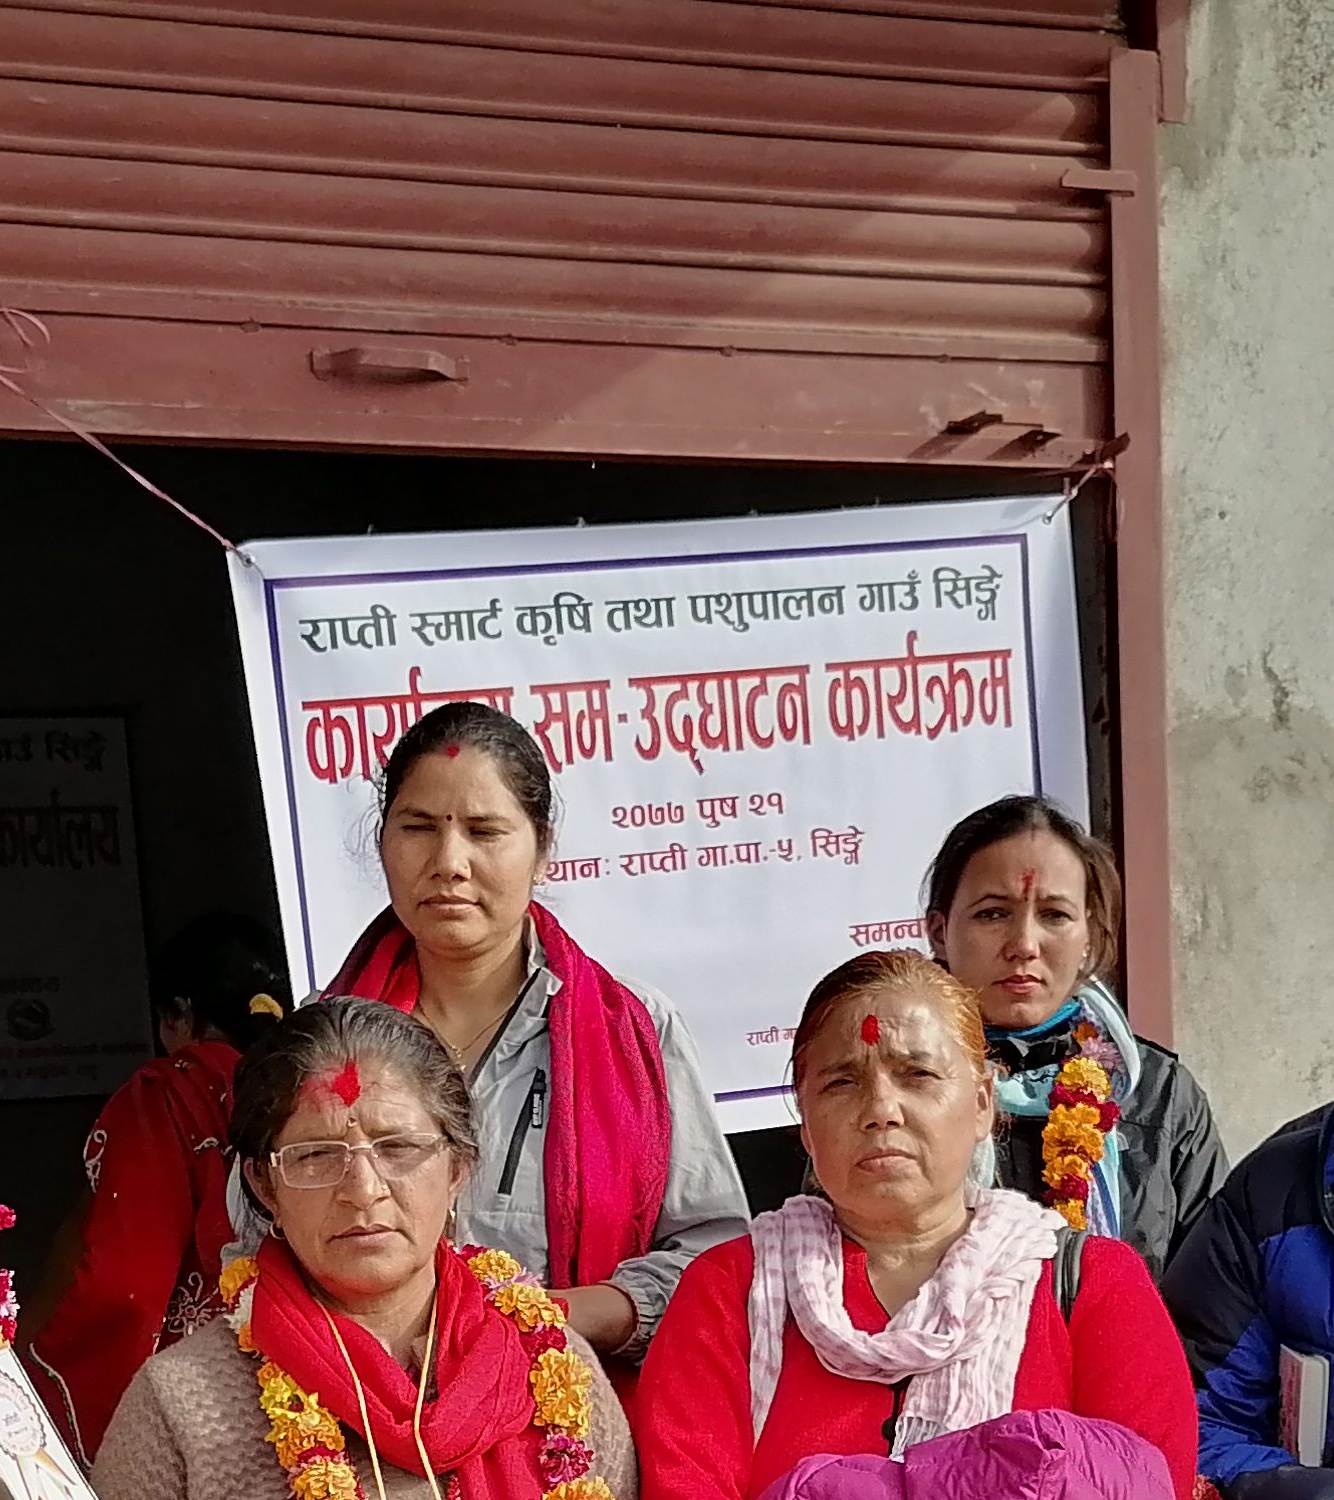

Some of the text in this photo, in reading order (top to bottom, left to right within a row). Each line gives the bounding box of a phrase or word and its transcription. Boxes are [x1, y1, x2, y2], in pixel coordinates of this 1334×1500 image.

[299, 604, 397, 653] राप्ती
[410, 598, 503, 646] स्मार्ट
[515, 591, 593, 646] कृषि
[604, 597, 676, 633] तथा
[688, 585, 845, 633] पशुपालन
[857, 569, 921, 613] गाउँ
[825, 630, 1013, 741] कार्यक्रम
[612, 792, 785, 829] २०७७ पुष २१
[620, 843, 688, 877] राप्ती
